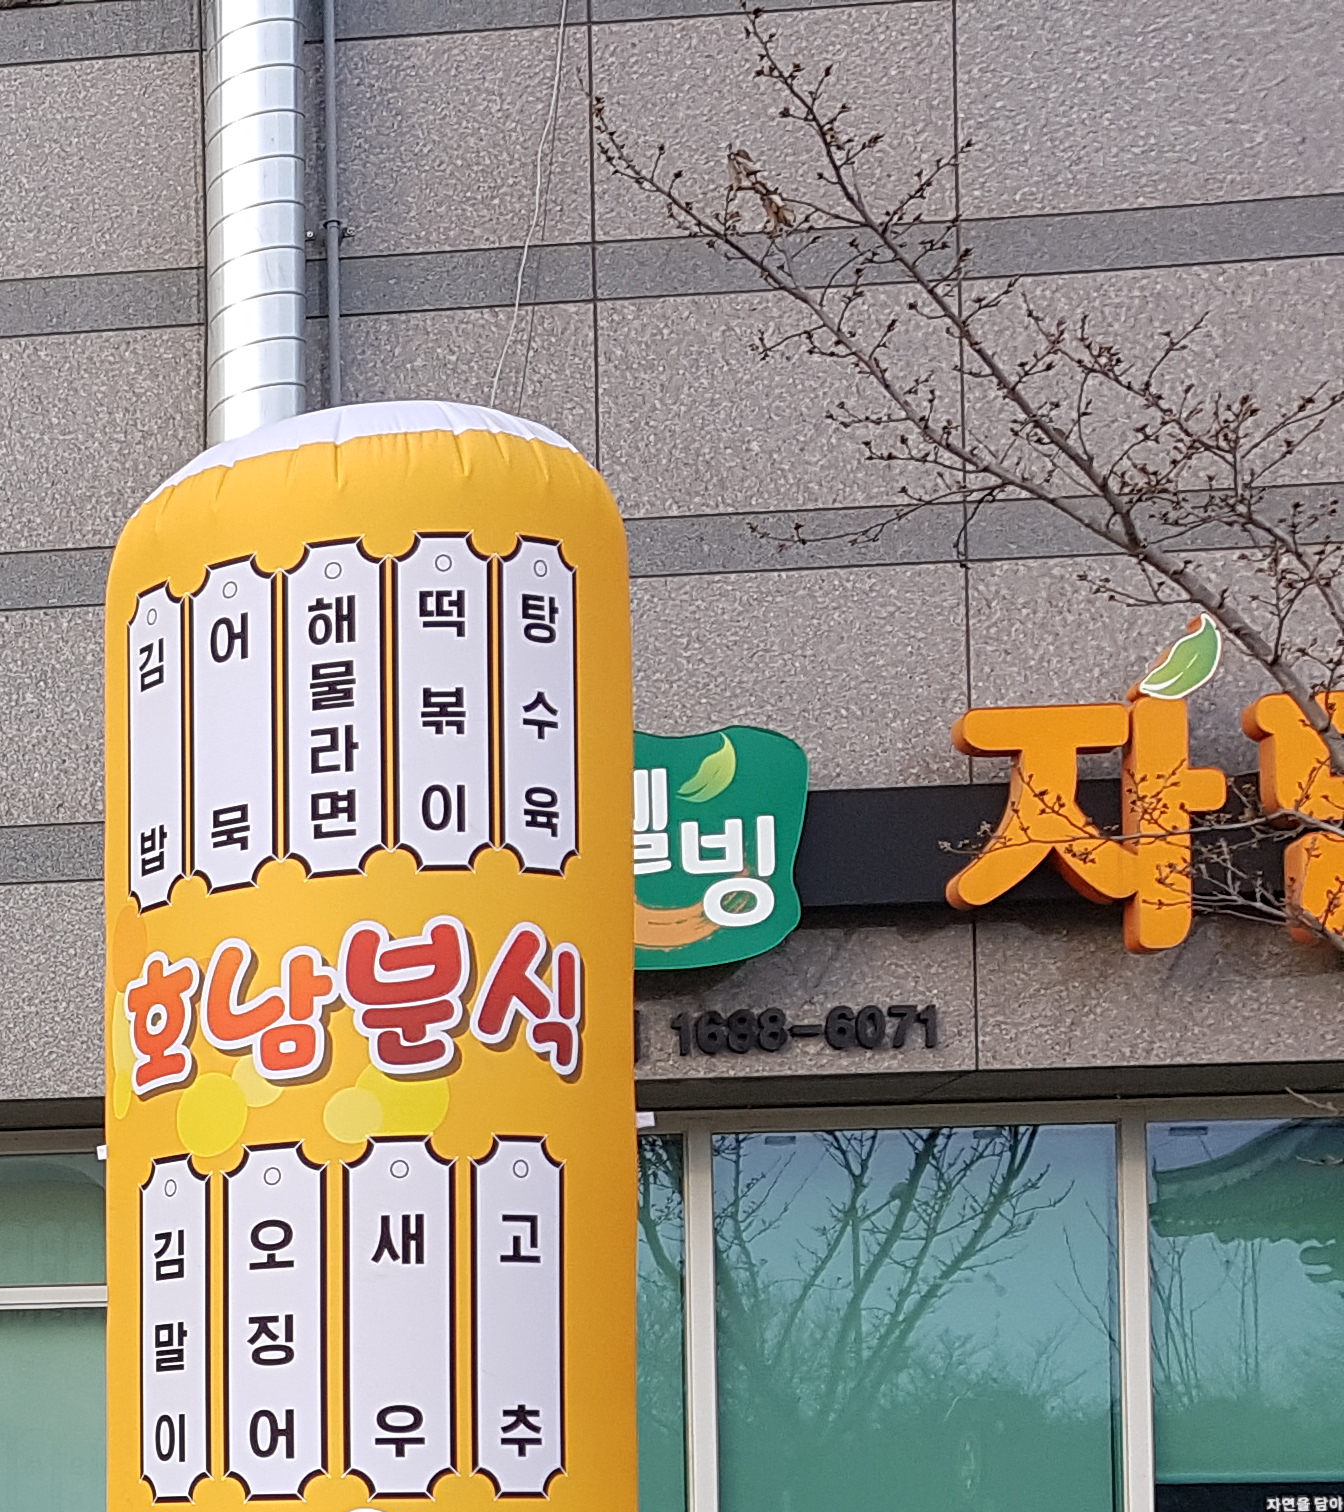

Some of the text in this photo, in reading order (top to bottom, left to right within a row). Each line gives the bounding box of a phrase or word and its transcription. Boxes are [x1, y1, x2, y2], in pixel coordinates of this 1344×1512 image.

[137, 637, 169, 877] 김밥
[209, 612, 251, 852] 어묵
[306, 594, 359, 839] 해물라면
[418, 588, 467, 833] 떡볶이
[520, 593, 560, 839] 탕수육
[670, 1003, 940, 1057] 1688-6071
[152, 1229, 188, 1464] 김말이
[246, 1218, 296, 1461] 오징어
[369, 1213, 426, 1458] 새우
[499, 1213, 543, 1457] 고추
[1266, 1496, 1311, 1512] 자연을
